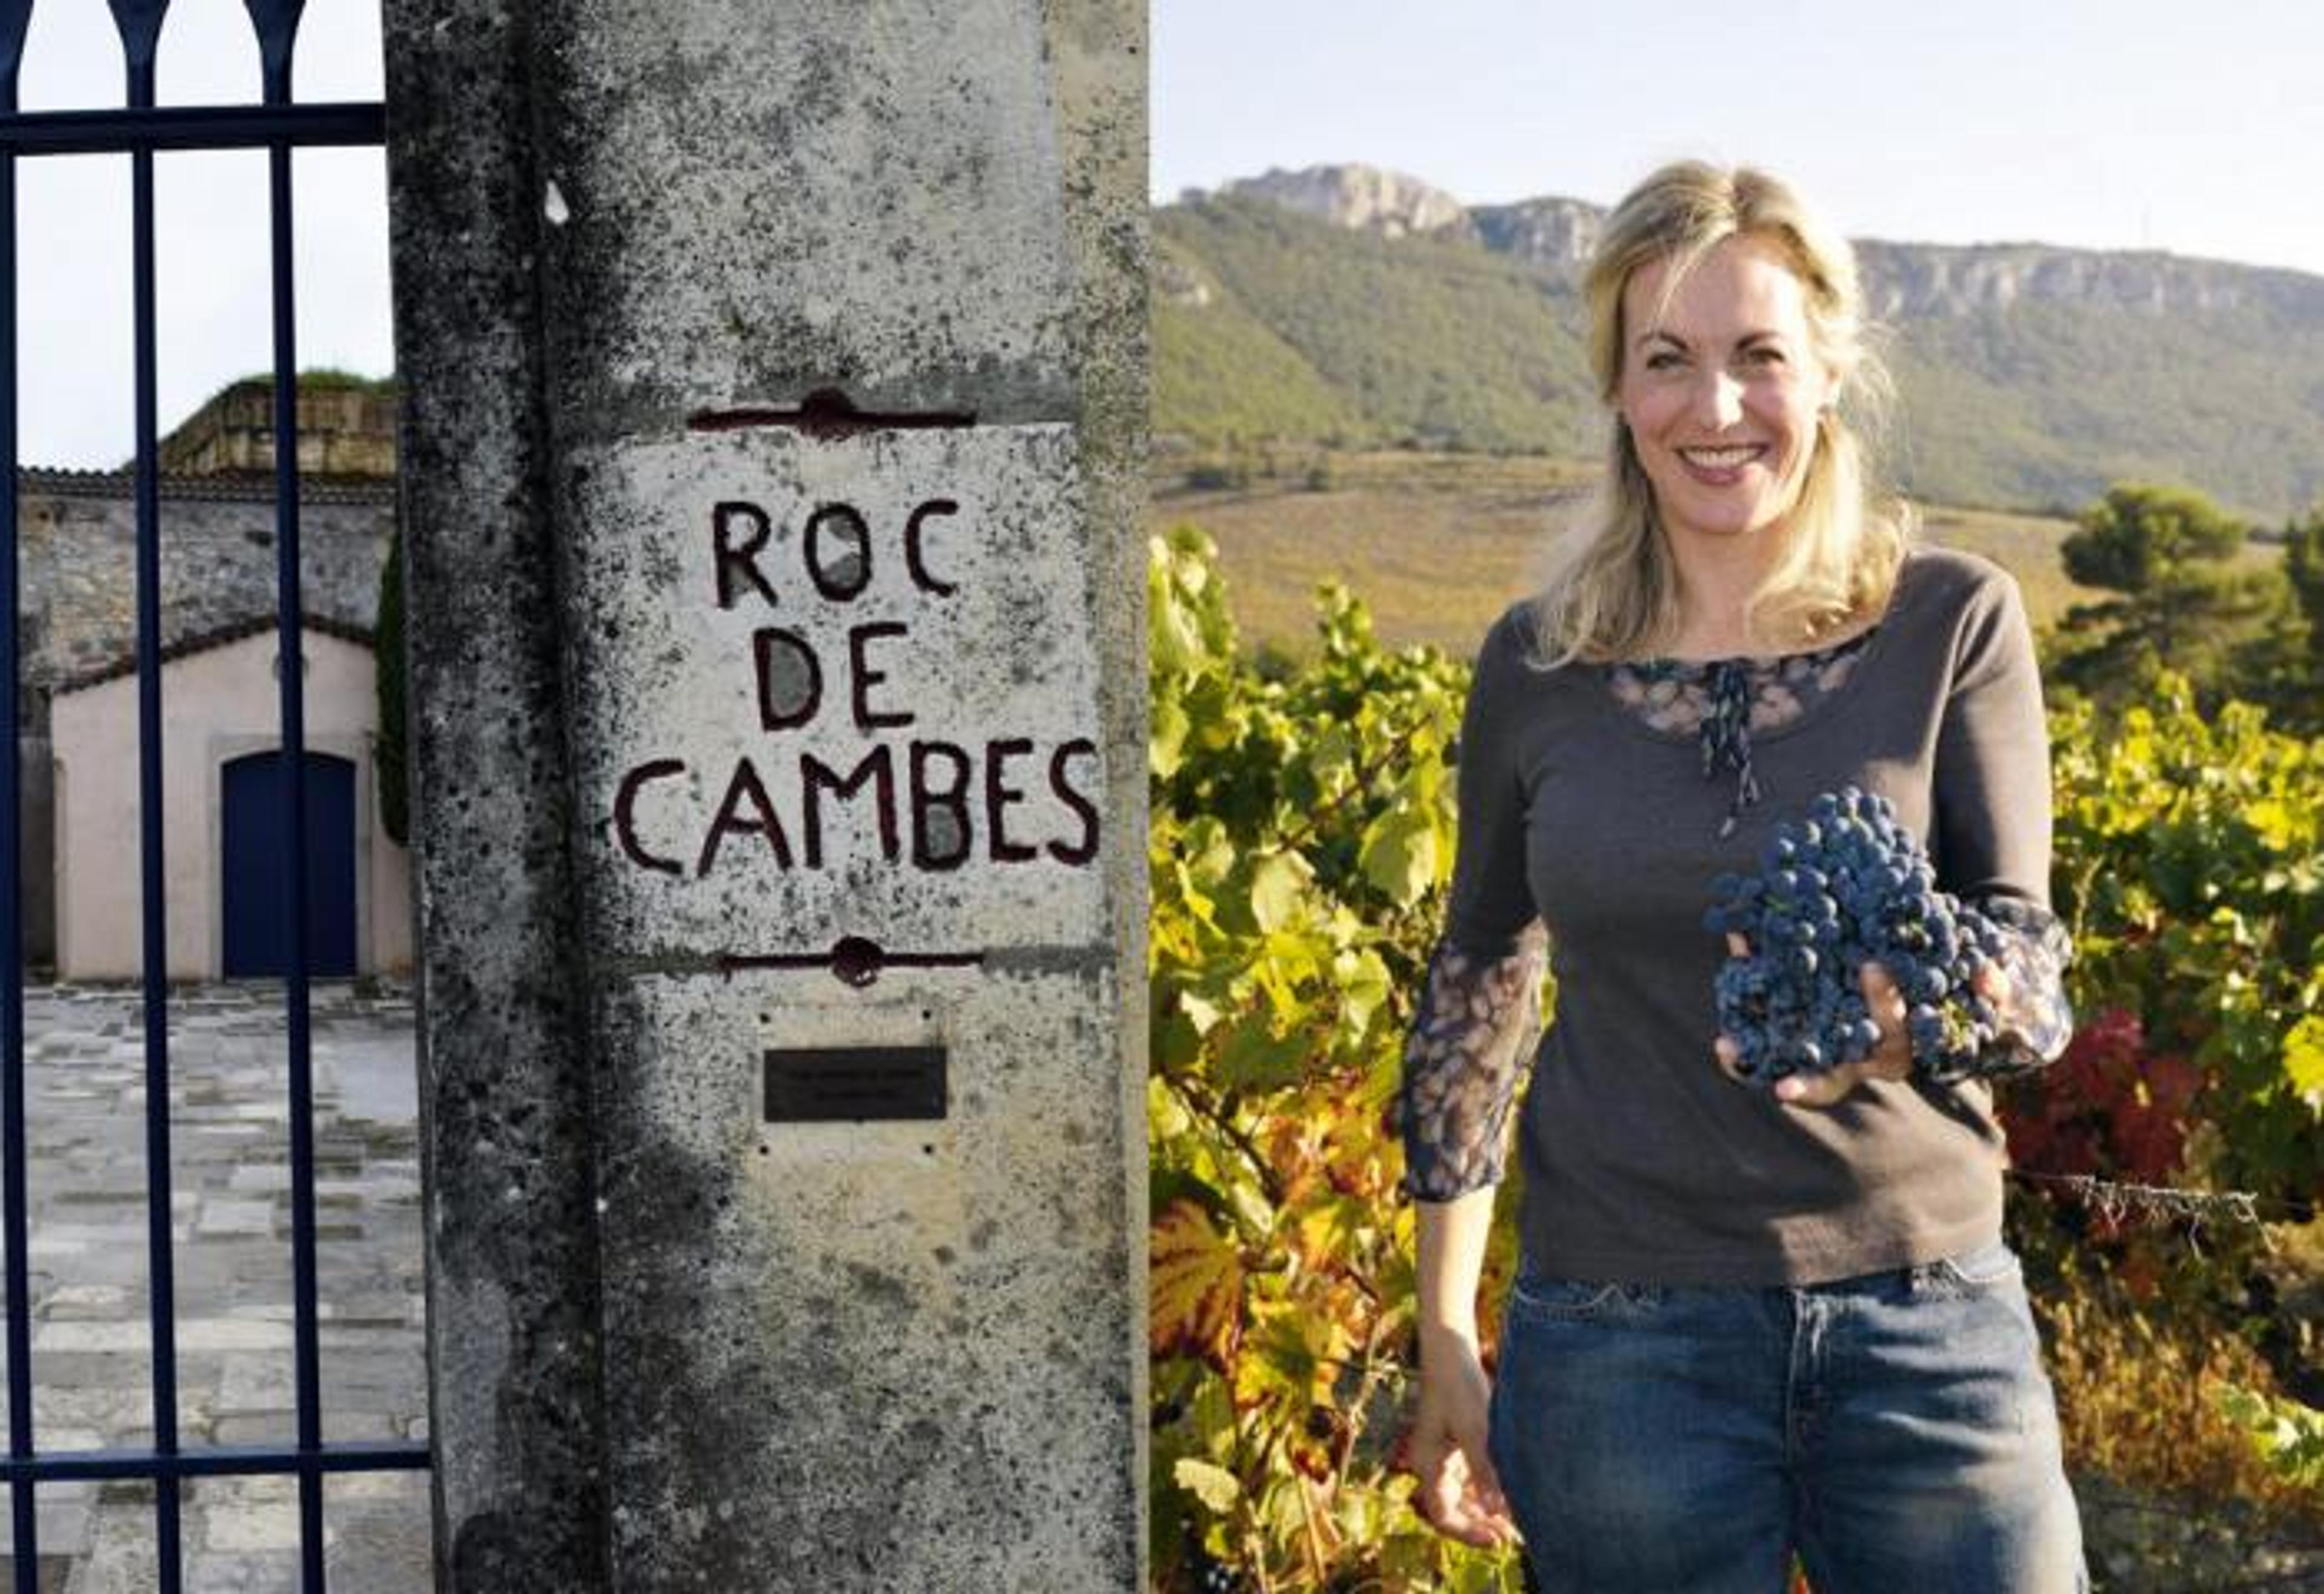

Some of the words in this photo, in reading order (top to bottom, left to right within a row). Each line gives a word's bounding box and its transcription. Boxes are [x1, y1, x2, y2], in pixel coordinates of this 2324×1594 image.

[711, 499, 959, 609] ROC
[753, 622, 915, 733] DE
[614, 737, 1100, 877] CAMBES
